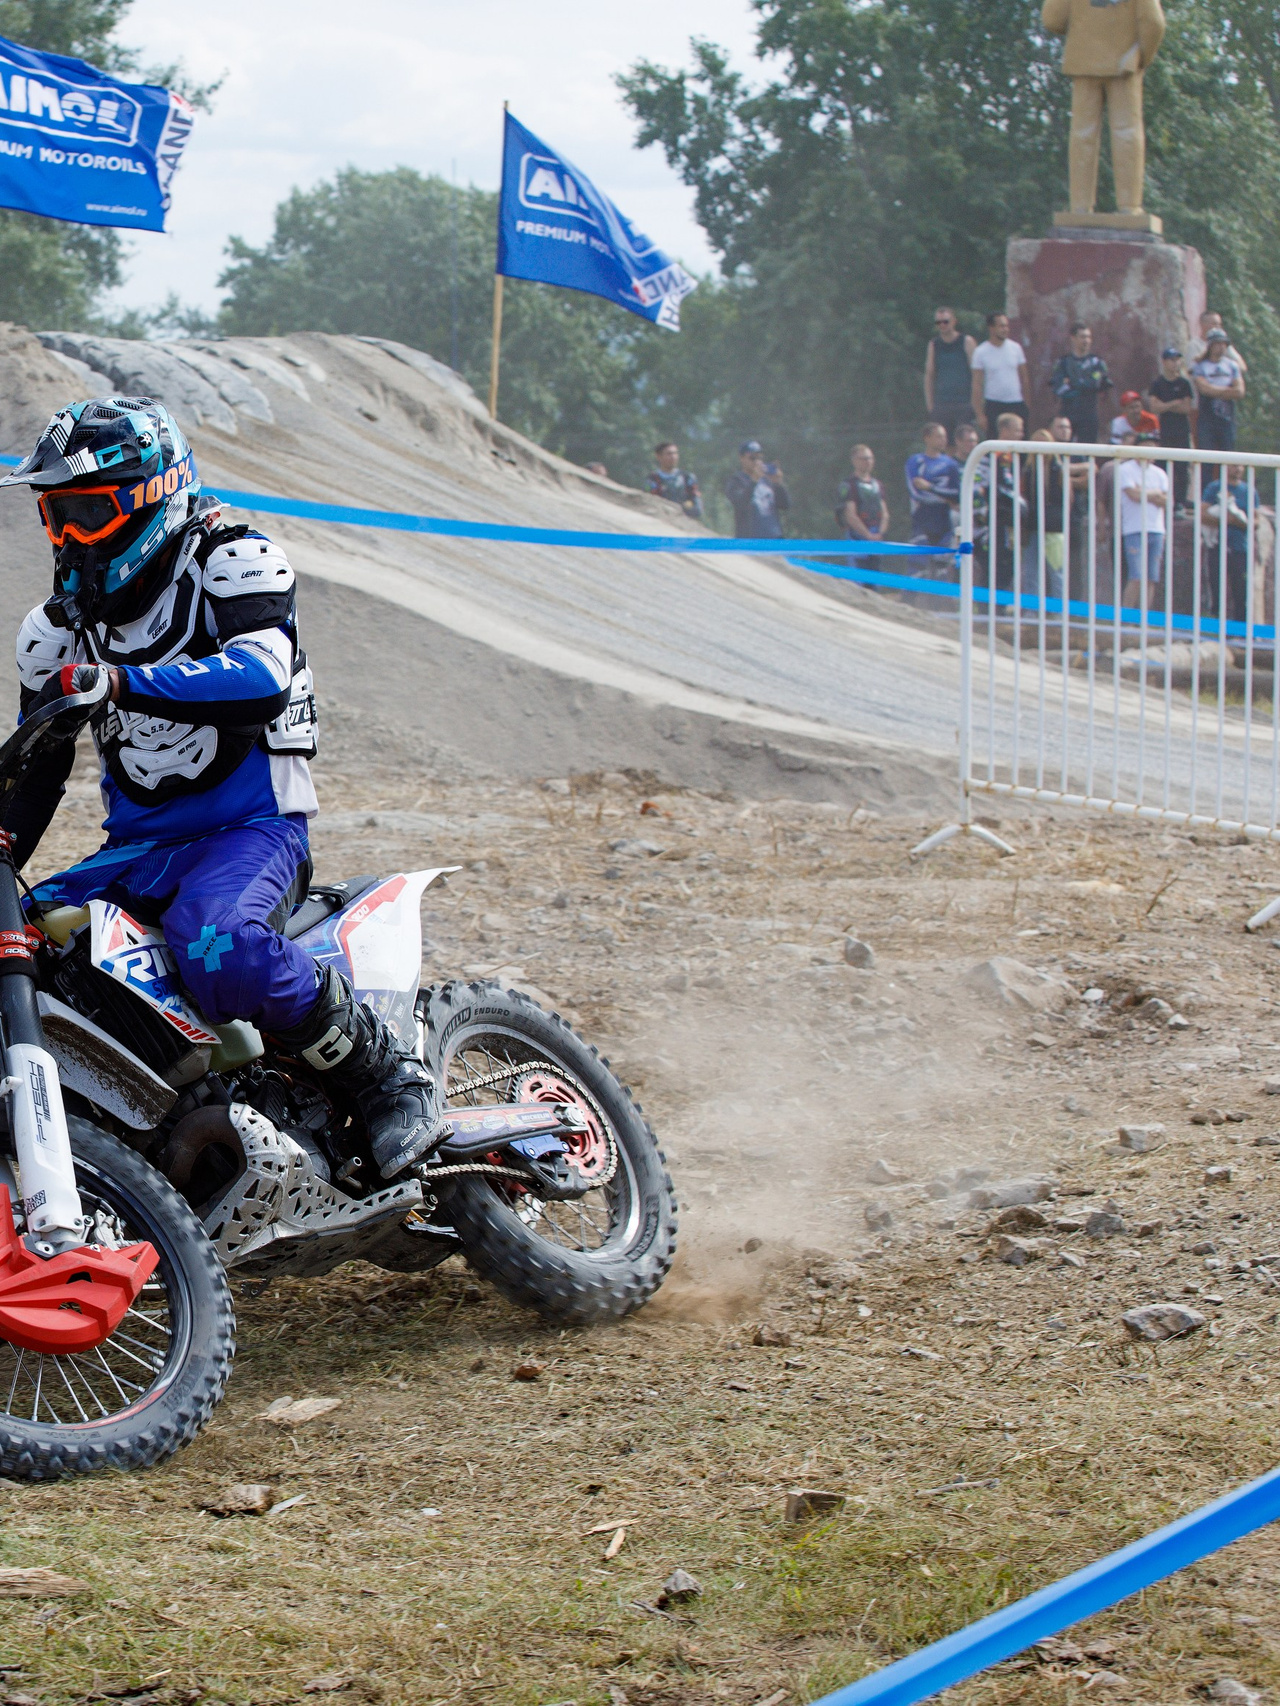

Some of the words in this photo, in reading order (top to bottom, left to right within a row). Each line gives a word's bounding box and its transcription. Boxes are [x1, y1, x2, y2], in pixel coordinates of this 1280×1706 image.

[39, 147, 148, 175] MOTOROILS
[516, 220, 587, 244] PREMIUM
[129, 457, 193, 509] 100%
[241, 570, 264, 579] LEATT
[151, 618, 169, 640] LEATT
[150, 723, 164, 734] 5.5
[474, 1007, 510, 1017] ENDURO
